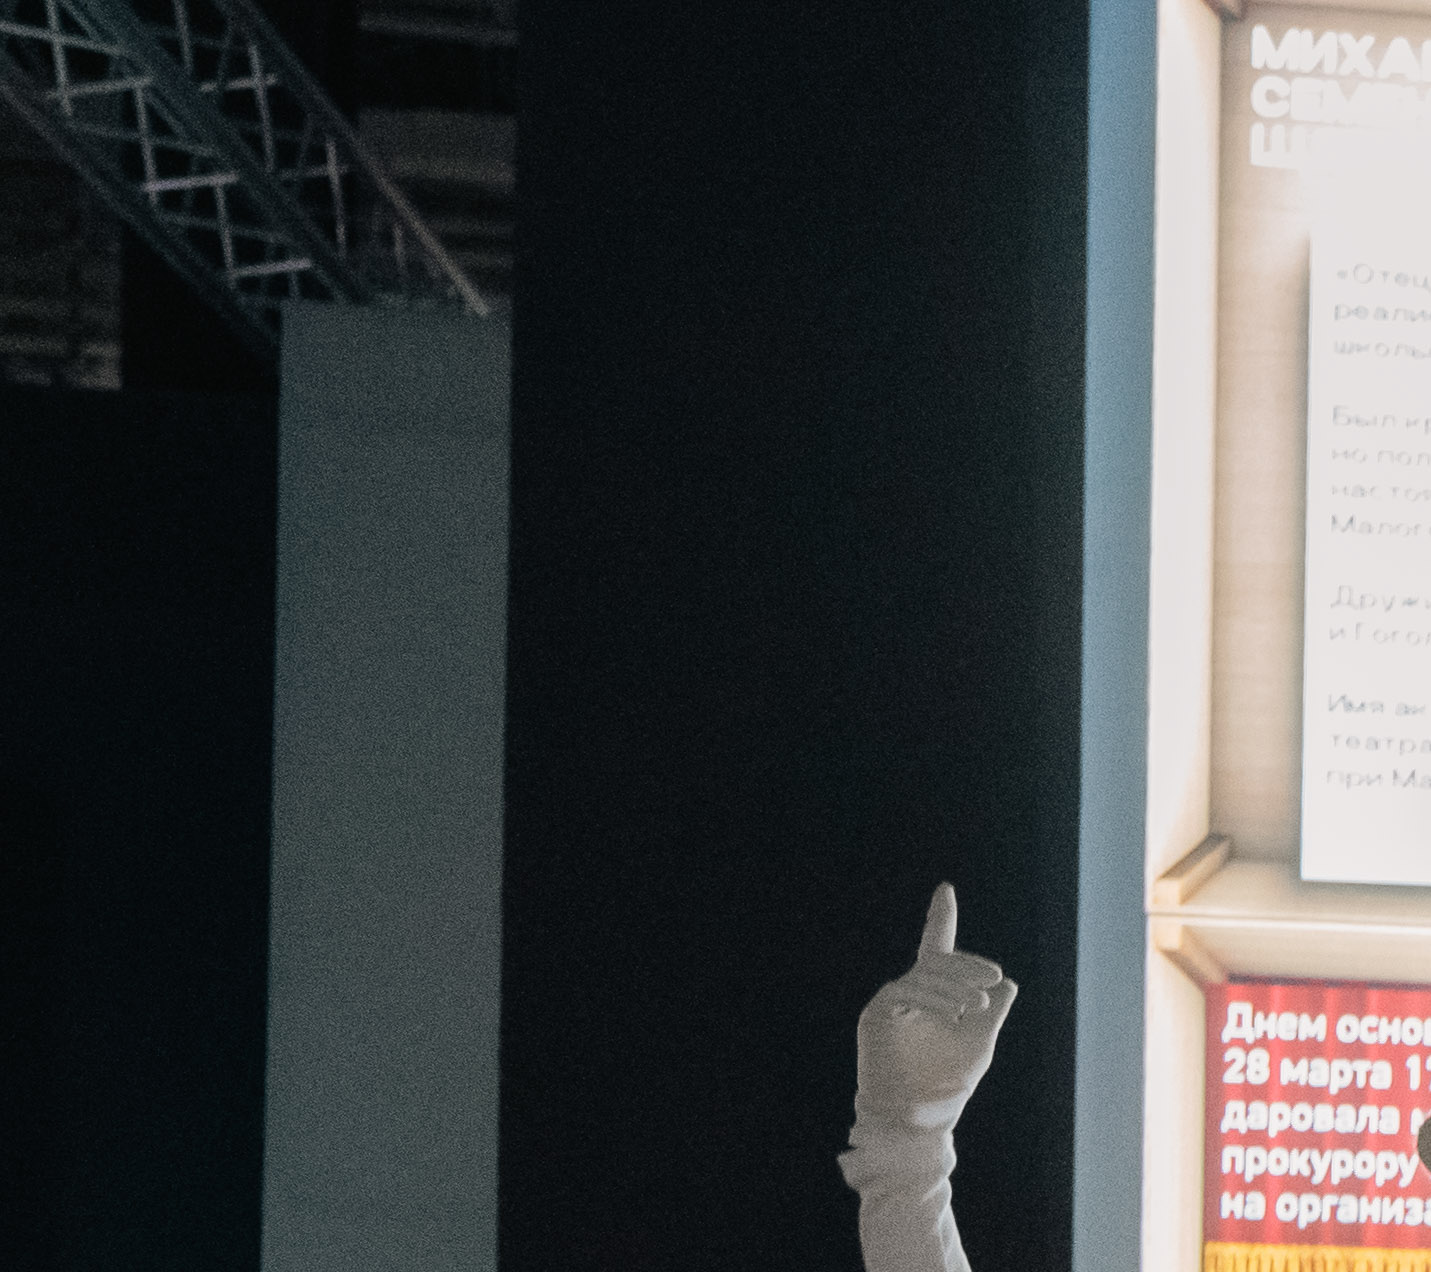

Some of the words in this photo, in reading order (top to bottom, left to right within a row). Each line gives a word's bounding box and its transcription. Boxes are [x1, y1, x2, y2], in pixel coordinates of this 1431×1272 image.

[1332, 404, 1397, 428] Был
[1332, 449, 1368, 464] но
[1328, 624, 1347, 643] и
[1327, 692, 1386, 715] Имя
[1325, 769, 1384, 792] при
[1221, 1001, 1327, 1043] Днем
[1223, 1046, 1270, 1085] 28
[1280, 1056, 1393, 1095] марта
[1221, 1099, 1401, 1138] даровала
[1221, 1144, 1420, 1188] прокурору
[1221, 1190, 1267, 1222] на
